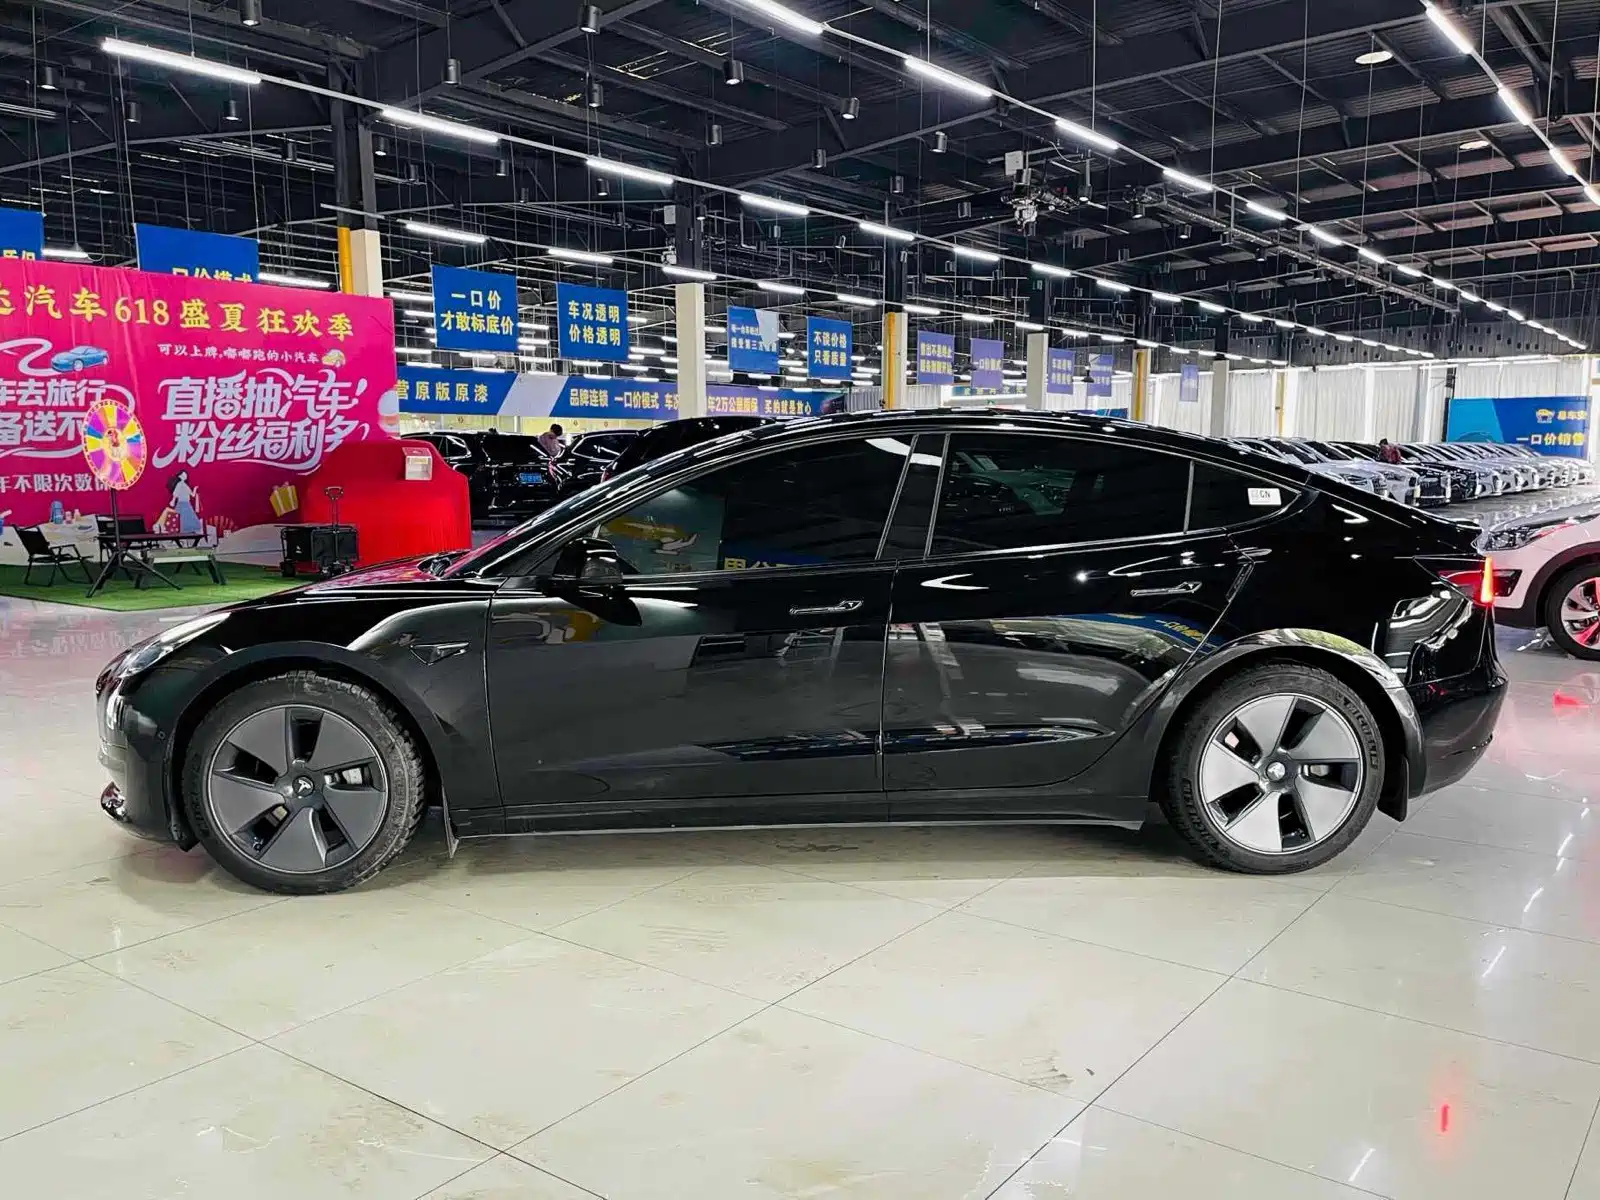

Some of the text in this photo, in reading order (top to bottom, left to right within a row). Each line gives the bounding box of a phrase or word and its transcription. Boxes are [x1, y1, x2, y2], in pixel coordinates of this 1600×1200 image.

[451, 290, 502, 311] 一口价
[568, 300, 620, 324] 车况透明
[440, 310, 514, 336] 才敢标底价
[568, 323, 621, 347] 价格透明
[569, 387, 609, 408] 品牌连锁
